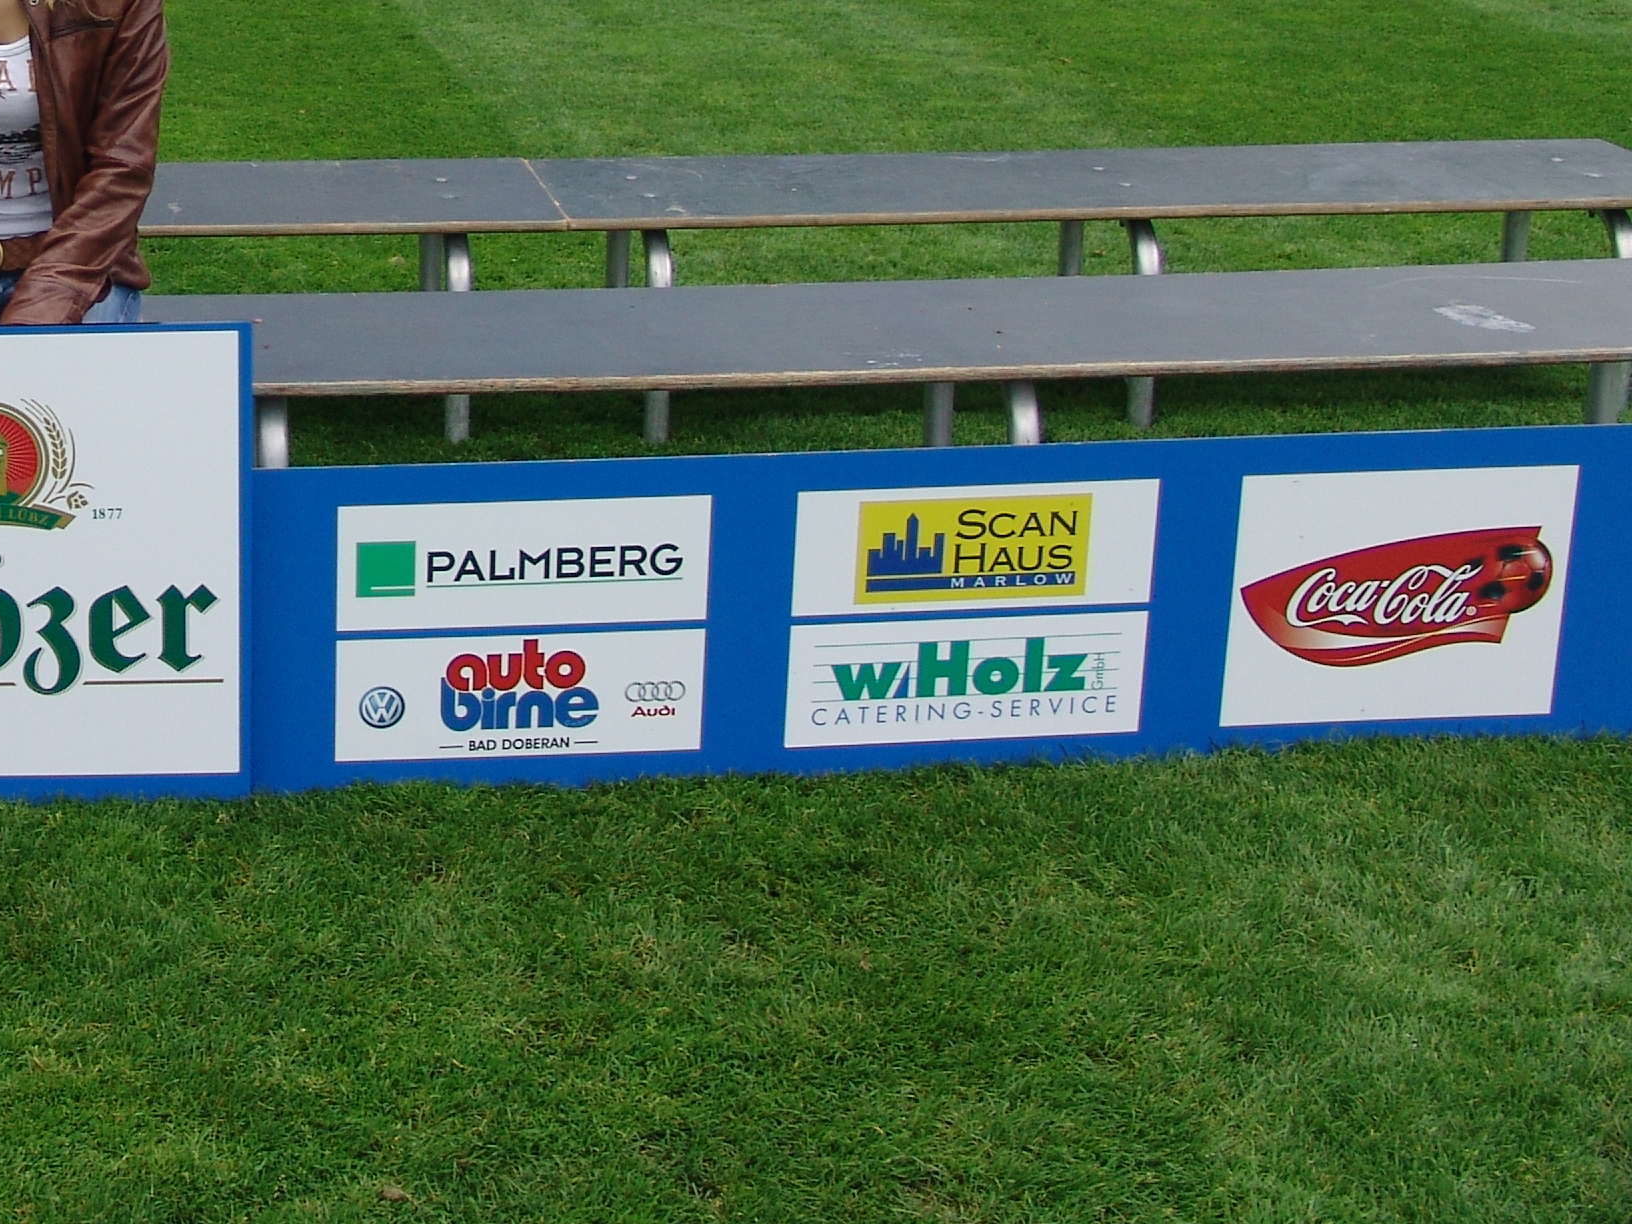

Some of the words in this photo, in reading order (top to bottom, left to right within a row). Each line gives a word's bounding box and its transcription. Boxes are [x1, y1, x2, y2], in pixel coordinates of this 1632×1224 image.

[91, 507, 123, 520] 1877
[955, 509, 1079, 540] SCAN
[426, 542, 683, 583] PALMBERG
[953, 543, 1073, 574] HAUS
[950, 573, 1074, 588] MARLOW
[1285, 563, 1483, 628] Coca-Cola
[446, 638, 586, 692] auto
[1091, 652, 1106, 690] GmbH
[440, 676, 599, 733] birne
[631, 705, 676, 717] Audi
[811, 695, 1117, 726] CATERING-SERVICE
[468, 739, 497, 751] BAD
[502, 737, 570, 750] DOBERAN
